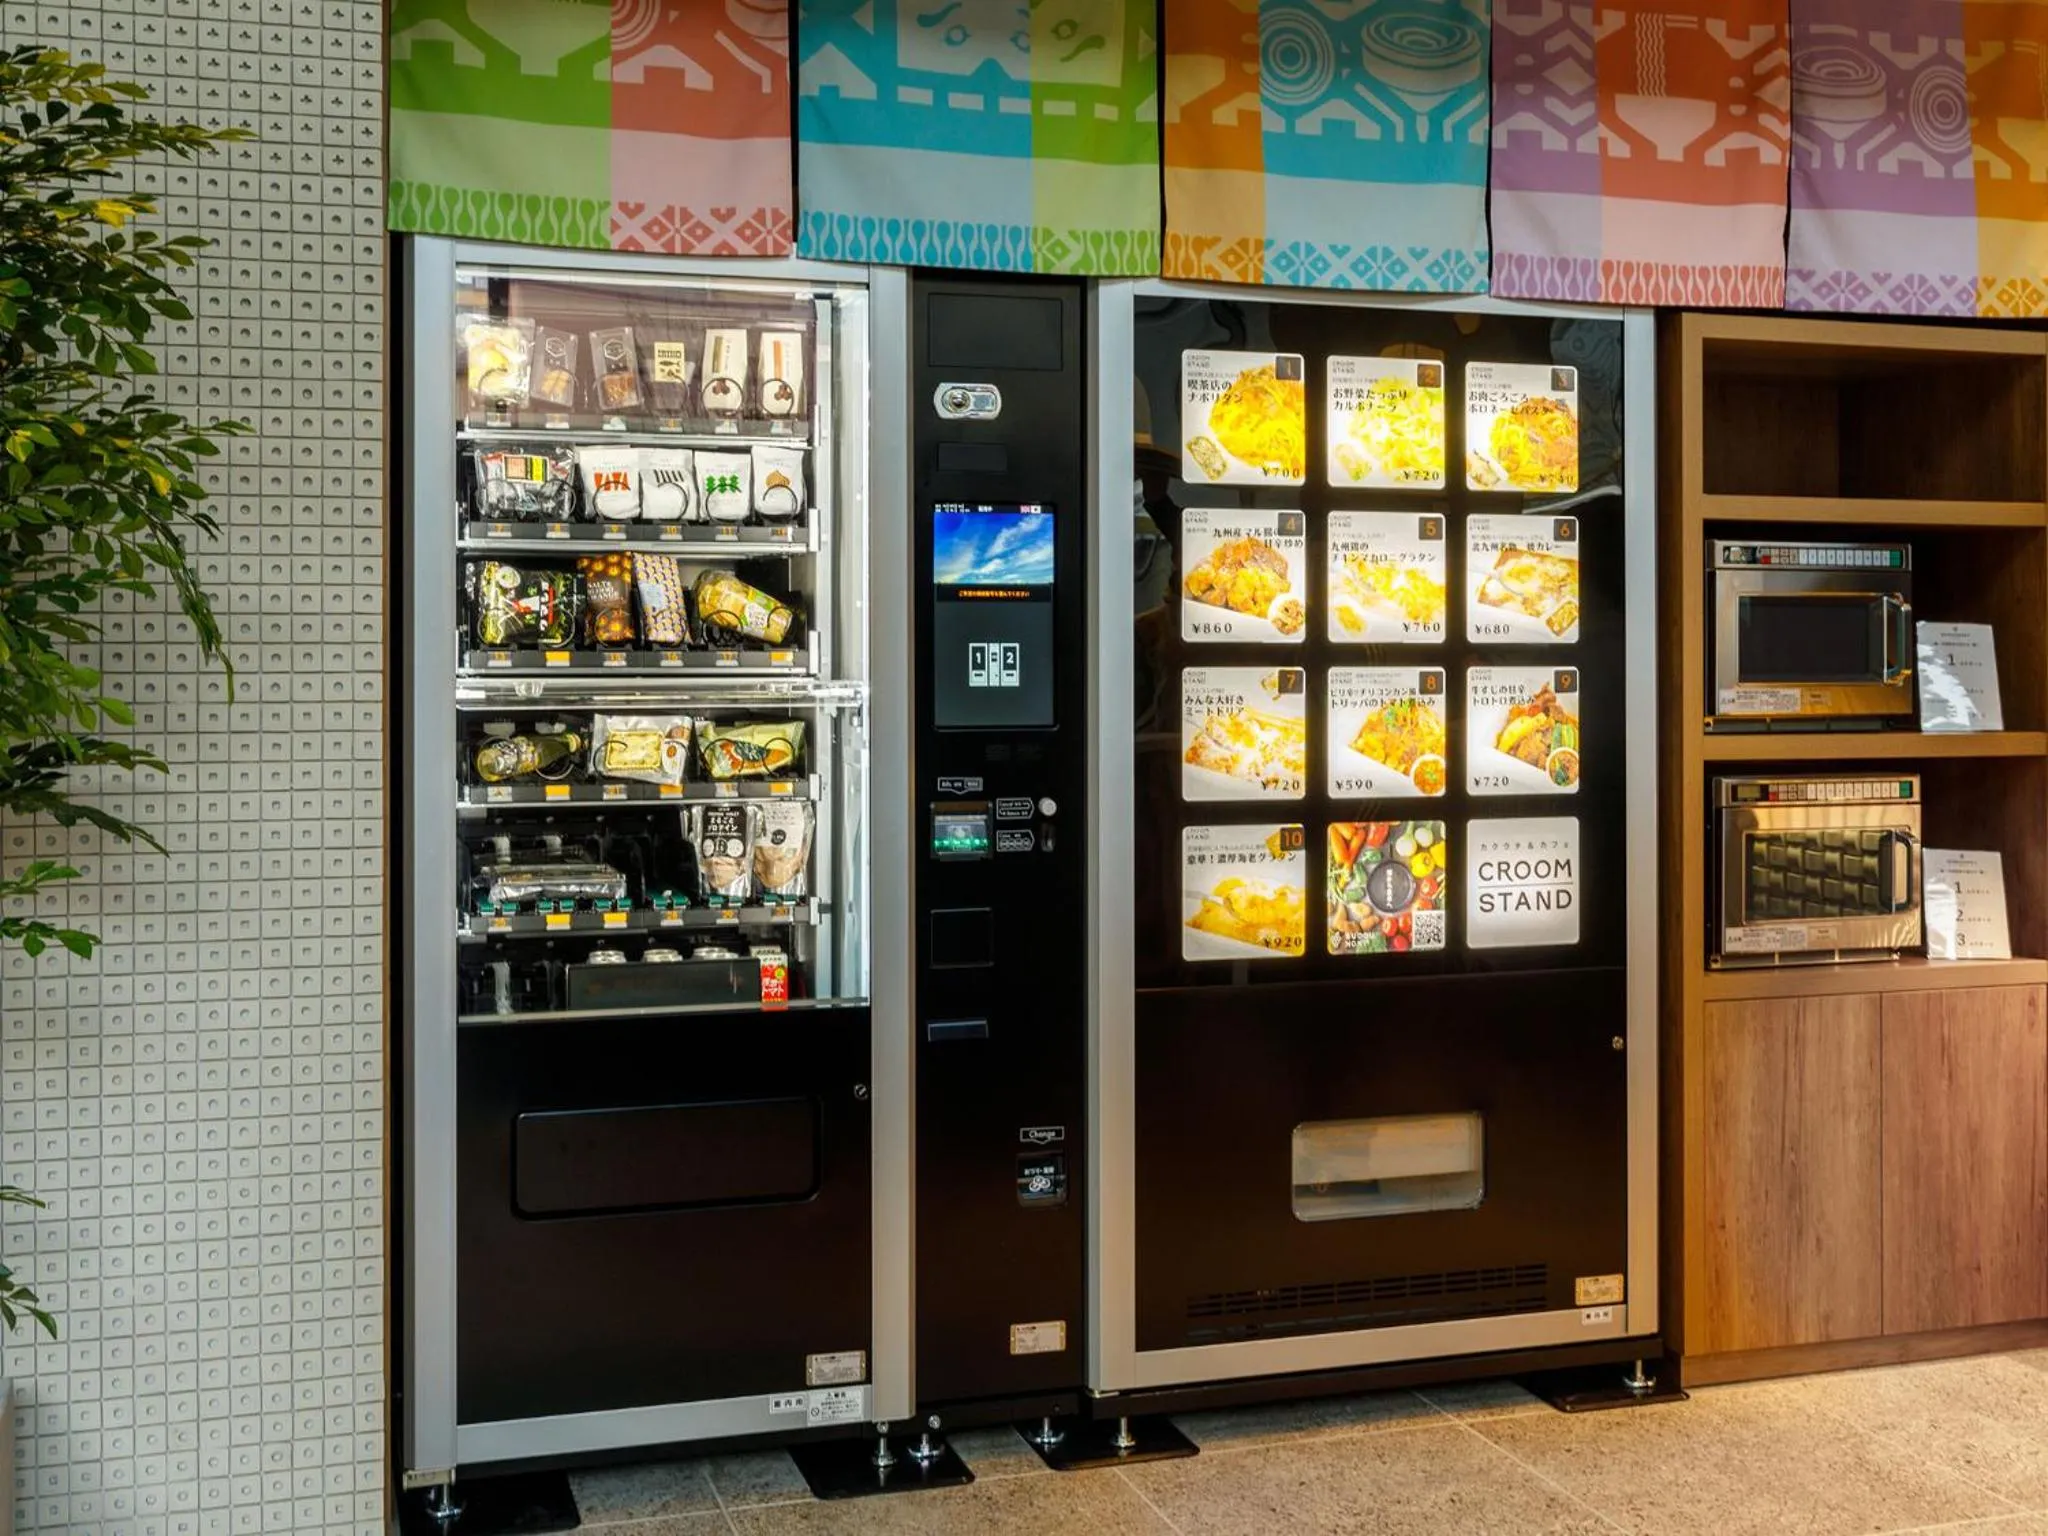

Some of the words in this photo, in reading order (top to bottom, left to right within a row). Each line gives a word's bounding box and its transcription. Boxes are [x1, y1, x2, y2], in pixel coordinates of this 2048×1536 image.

[1423, 369, 1435, 384] 2
[1187, 379, 1232, 390] 喫茶店の
[1188, 392, 1243, 403] ナポリタン
[1333, 387, 1407, 399] お野菜たっぷり
[1468, 391, 1528, 402] お肉ごろごろ
[1333, 401, 1397, 412] カルボナーラ
[1262, 467, 1300, 478] ¥700
[1403, 470, 1440, 481] ¥720
[1285, 515, 1296, 532] 4
[1425, 522, 1437, 536] 5
[1560, 523, 1570, 537] 6
[1471, 543, 1518, 552] 北九州名物
[1332, 553, 1436, 564] チキンマカロニグラタン
[1192, 623, 1232, 634] ¥860
[1403, 623, 1440, 633] ¥760
[1475, 624, 1510, 634] ¥680
[975, 652, 982, 664] 1
[1006, 652, 1014, 664] 2
[1947, 653, 1956, 666] 1
[1286, 673, 1296, 689] 7
[1426, 675, 1437, 690] 8
[1561, 674, 1571, 688] 9
[1184, 695, 1244, 705] みんな大好き
[1186, 706, 1244, 717] ミートドリア
[1262, 779, 1300, 790] ¥720
[1336, 779, 1373, 790] ¥590
[1474, 776, 1510, 787] ¥720
[1284, 830, 1303, 847] 10
[1478, 858, 1573, 882] CROOM
[1955, 881, 1963, 894] 1
[1479, 889, 1573, 913] STAND
[1956, 908, 1964, 922] 2
[1265, 936, 1303, 948] ¥920
[1956, 932, 1966, 946] 3
[1029, 1130, 1056, 1140] Change
